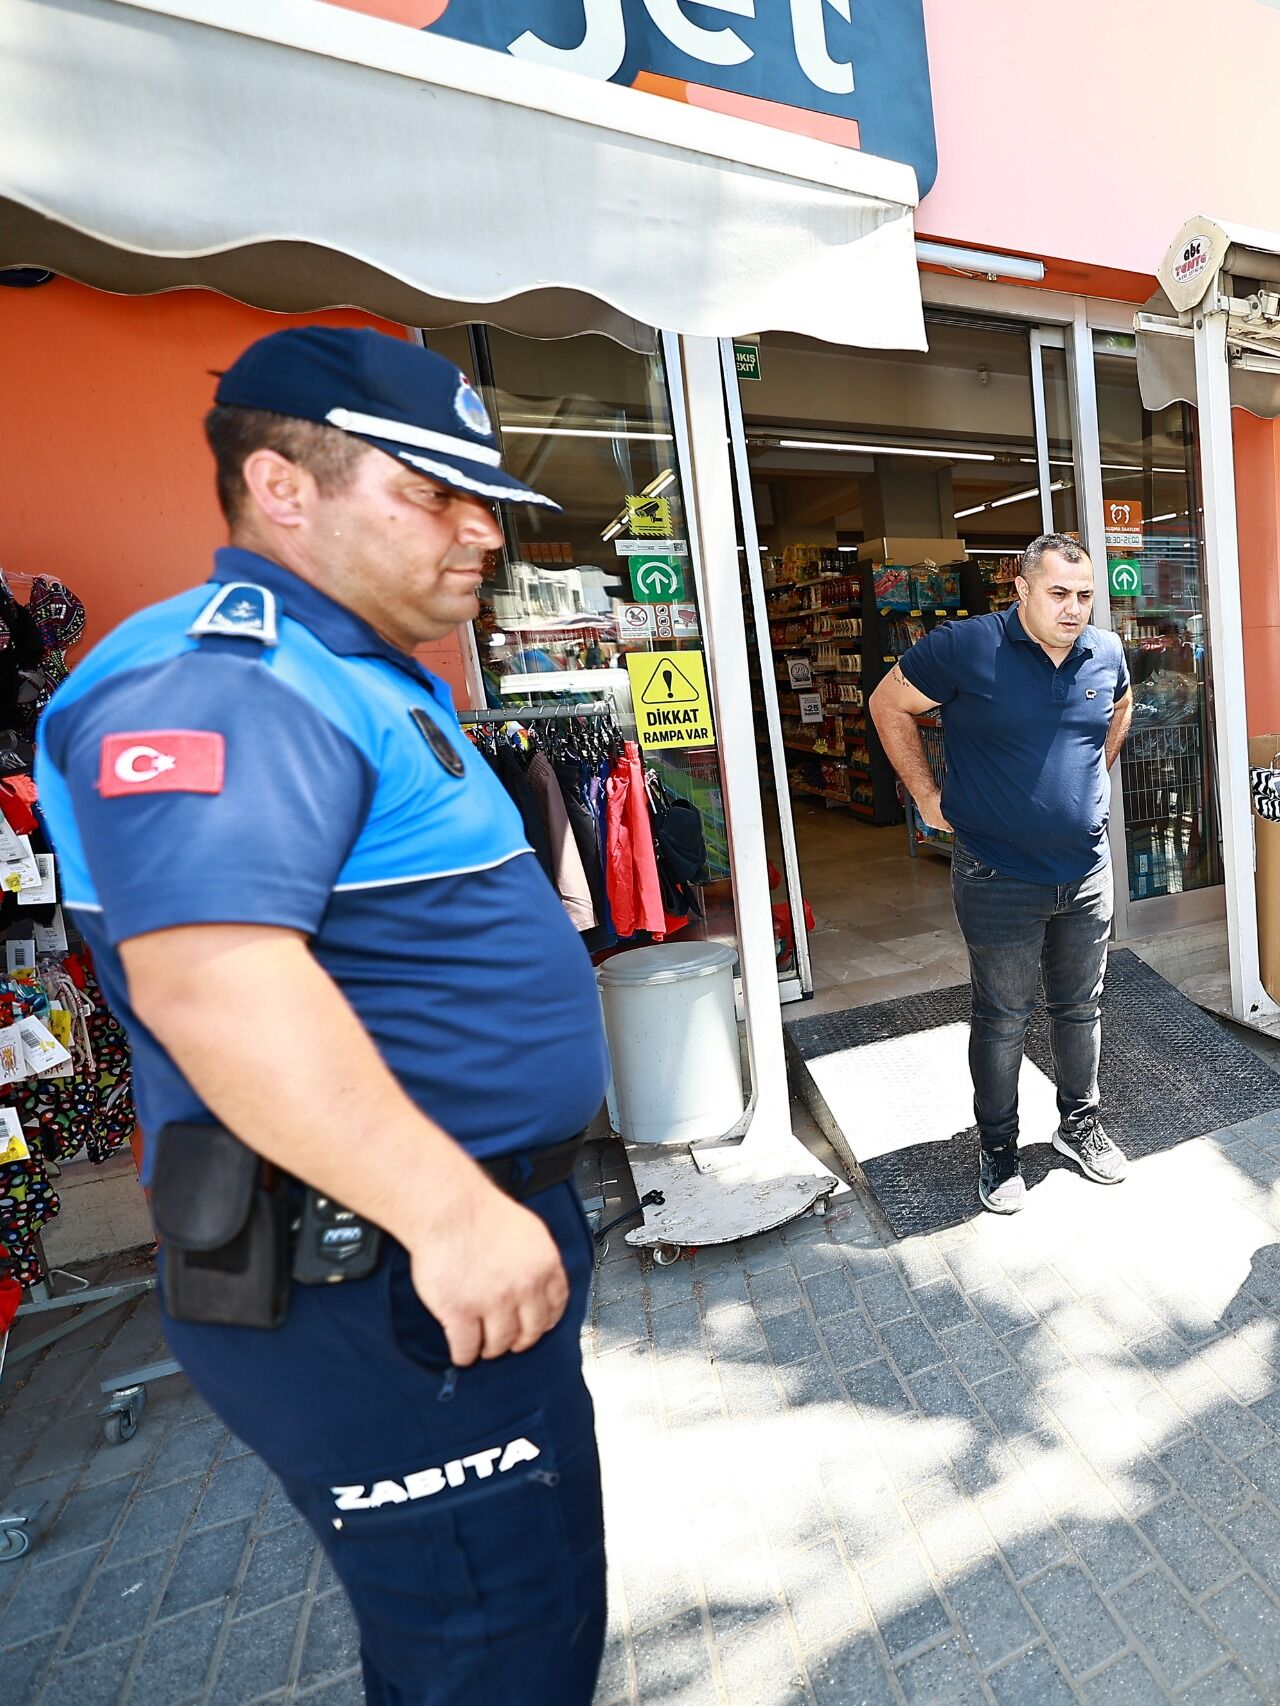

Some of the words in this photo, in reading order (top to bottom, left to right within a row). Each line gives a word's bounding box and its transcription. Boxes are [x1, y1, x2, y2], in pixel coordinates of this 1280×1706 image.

[1183, 242, 1201, 261] abc
[736, 352, 756, 366] IKIŞ
[736, 362, 754, 372] EXIT
[646, 708, 699, 727] DİKKAT
[643, 730, 685, 744] RAMPA
[685, 728, 709, 740] VAR
[330, 1437, 541, 1511] ZABITA
